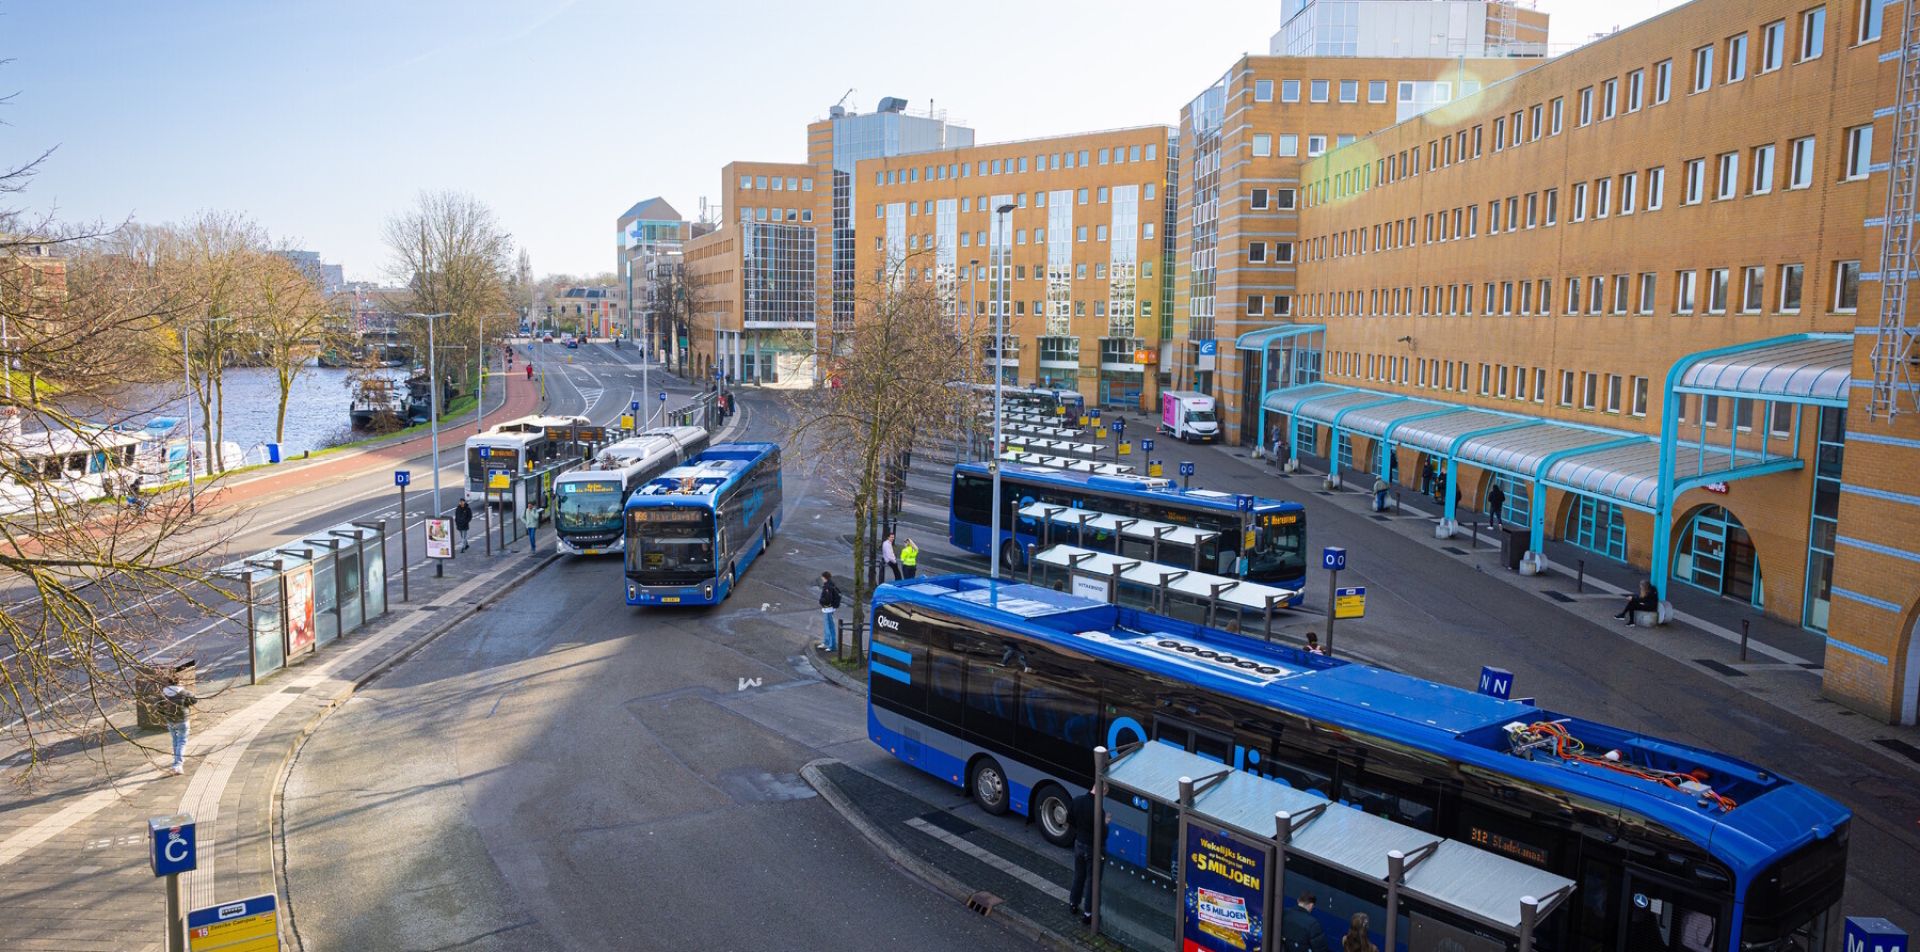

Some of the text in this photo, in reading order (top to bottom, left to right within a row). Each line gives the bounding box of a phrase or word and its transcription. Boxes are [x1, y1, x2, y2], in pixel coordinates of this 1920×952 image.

[481, 448, 487, 456] E
[398, 474, 405, 483] D
[1239, 499, 1246, 508] P
[1247, 500, 1252, 508] P
[1326, 554, 1335, 565] O
[1338, 555, 1344, 566] O
[877, 615, 899, 631] Qbuzz
[1481, 674, 1490, 690] N
[1493, 679, 1508, 694] N
[1471, 826, 1489, 844] 312
[165, 837, 189, 862] C
[1200, 838, 1257, 868] Wekelijks kans
[1208, 859, 1260, 890] MILJOEN
[1212, 907, 1247, 920] MILJOEN
[198, 929, 209, 938] 15
[1847, 932, 1865, 952] M
